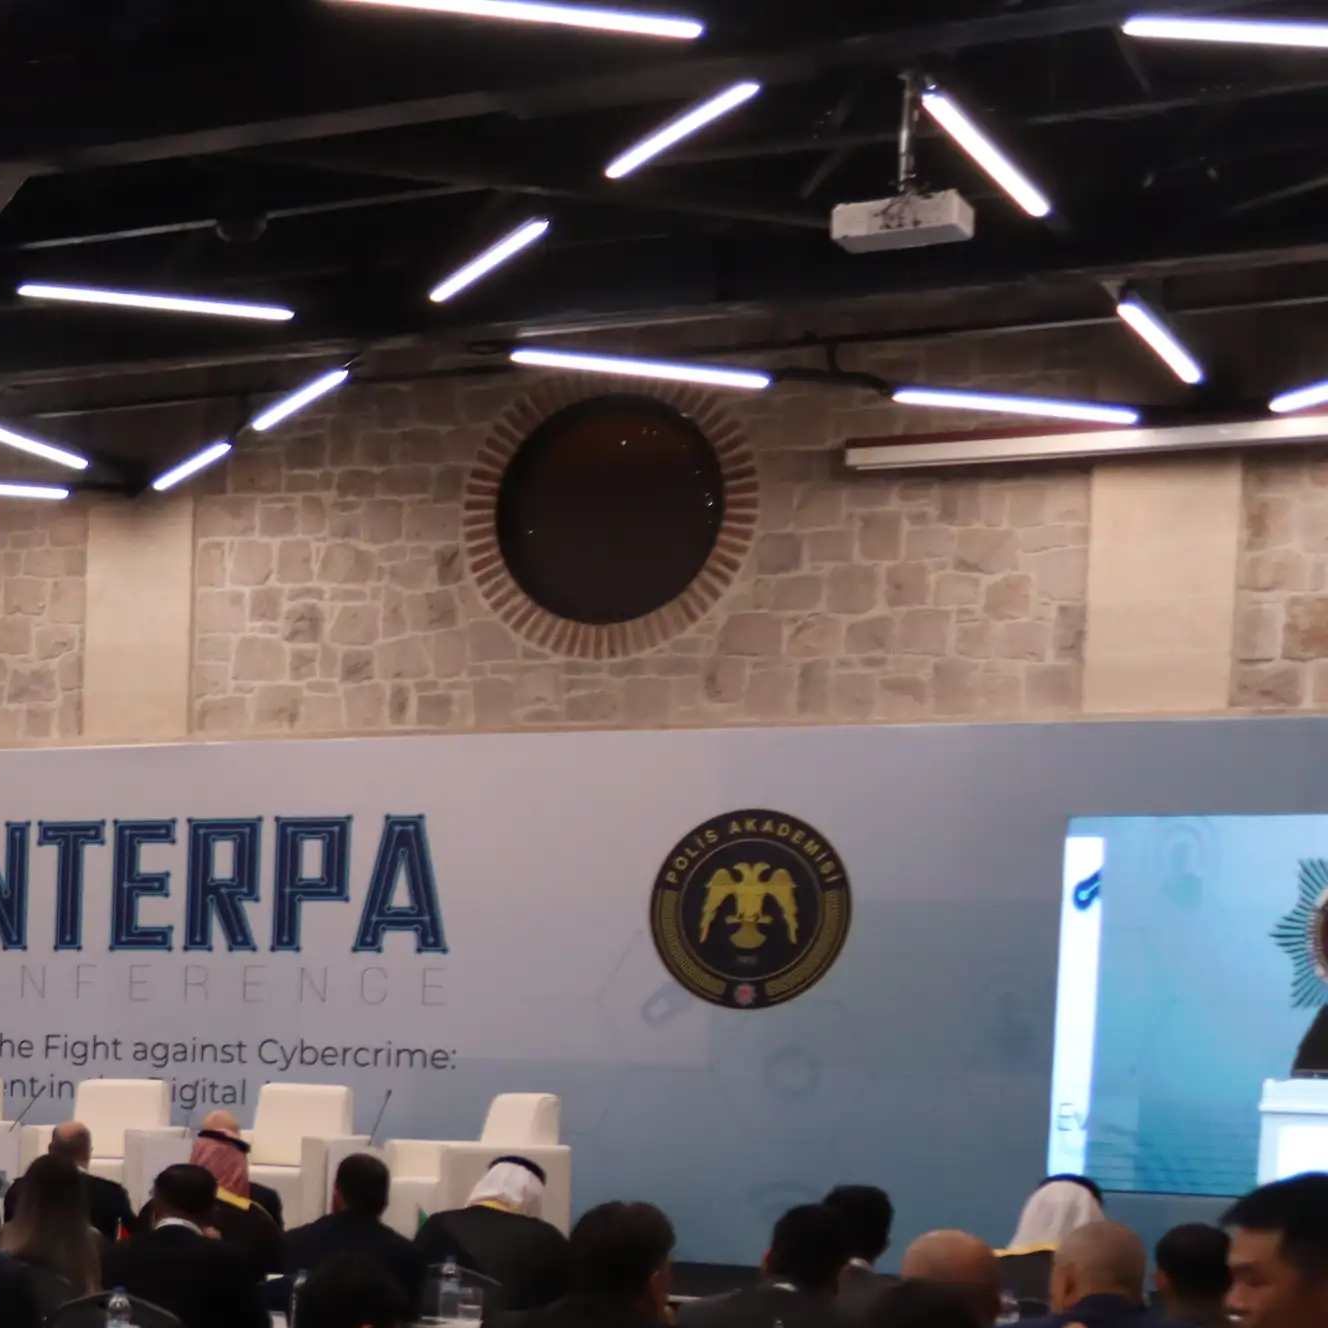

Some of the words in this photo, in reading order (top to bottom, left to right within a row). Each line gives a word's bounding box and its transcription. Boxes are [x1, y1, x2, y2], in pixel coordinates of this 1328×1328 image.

[43, 1033, 123, 1067] Fight
[132, 1038, 248, 1069] against
[257, 1036, 457, 1072] Cybercrime:
[49, 1073, 76, 1099] in
[149, 1077, 248, 1111] igital
